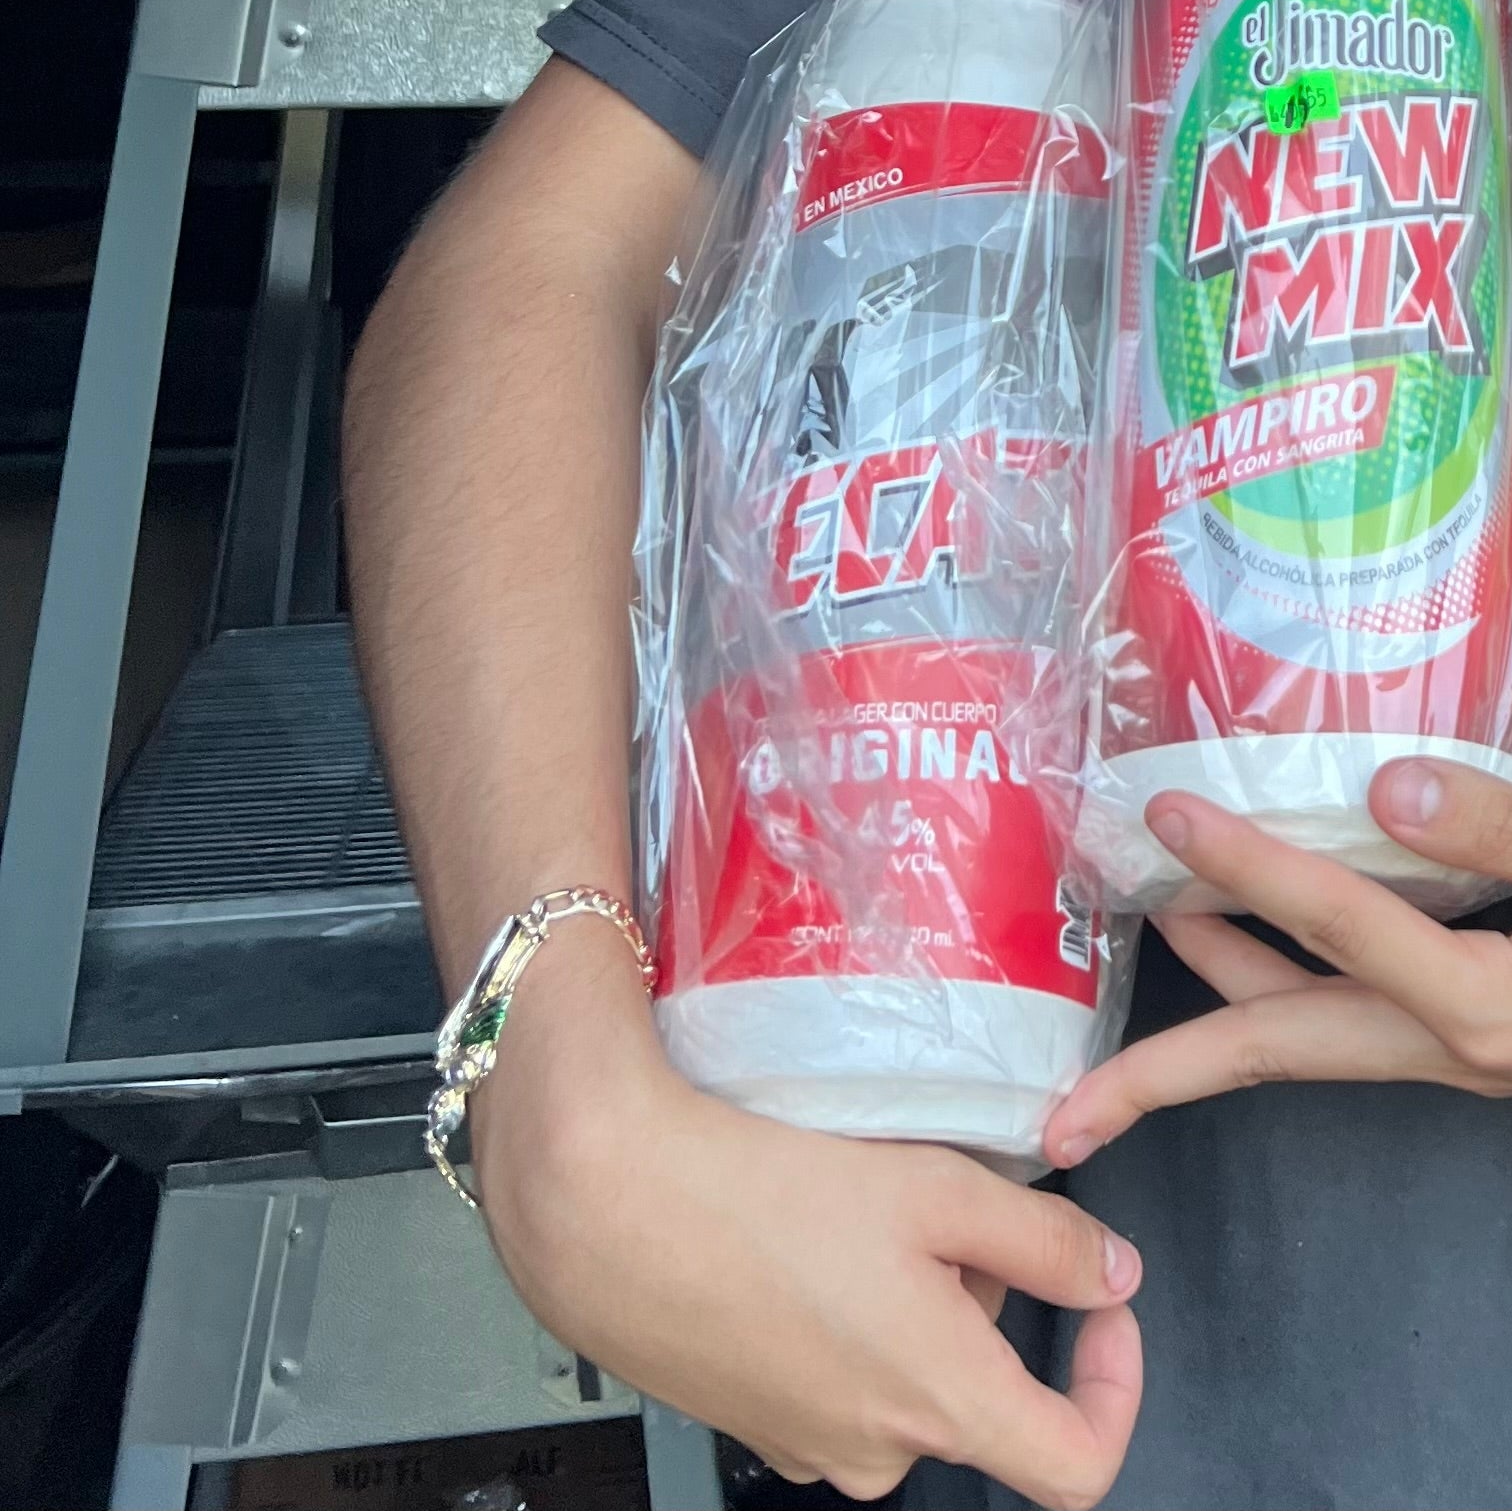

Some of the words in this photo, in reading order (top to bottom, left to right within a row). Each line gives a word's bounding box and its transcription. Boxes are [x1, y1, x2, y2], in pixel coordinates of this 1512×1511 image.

[1242, 2, 1269, 48] el
[803, 195, 827, 223] EN
[828, 167, 904, 209] MEXICO
[1188, 95, 1480, 264] NEW
[1228, 212, 1475, 368] MIX
[1154, 374, 1378, 490] VAMPIRO
[1163, 465, 1229, 509] TEQUILA
[1232, 451, 1272, 478] CON
[1275, 427, 1365, 465] SANGRITA
[1338, 556, 1424, 587] PREPARADA
[1422, 537, 1452, 562] CON
[1446, 492, 1483, 541] TEQUILA
[890, 700, 929, 723] CON
[931, 701, 997, 725] CUERPO
[748, 726, 1032, 796] OIGINAL
